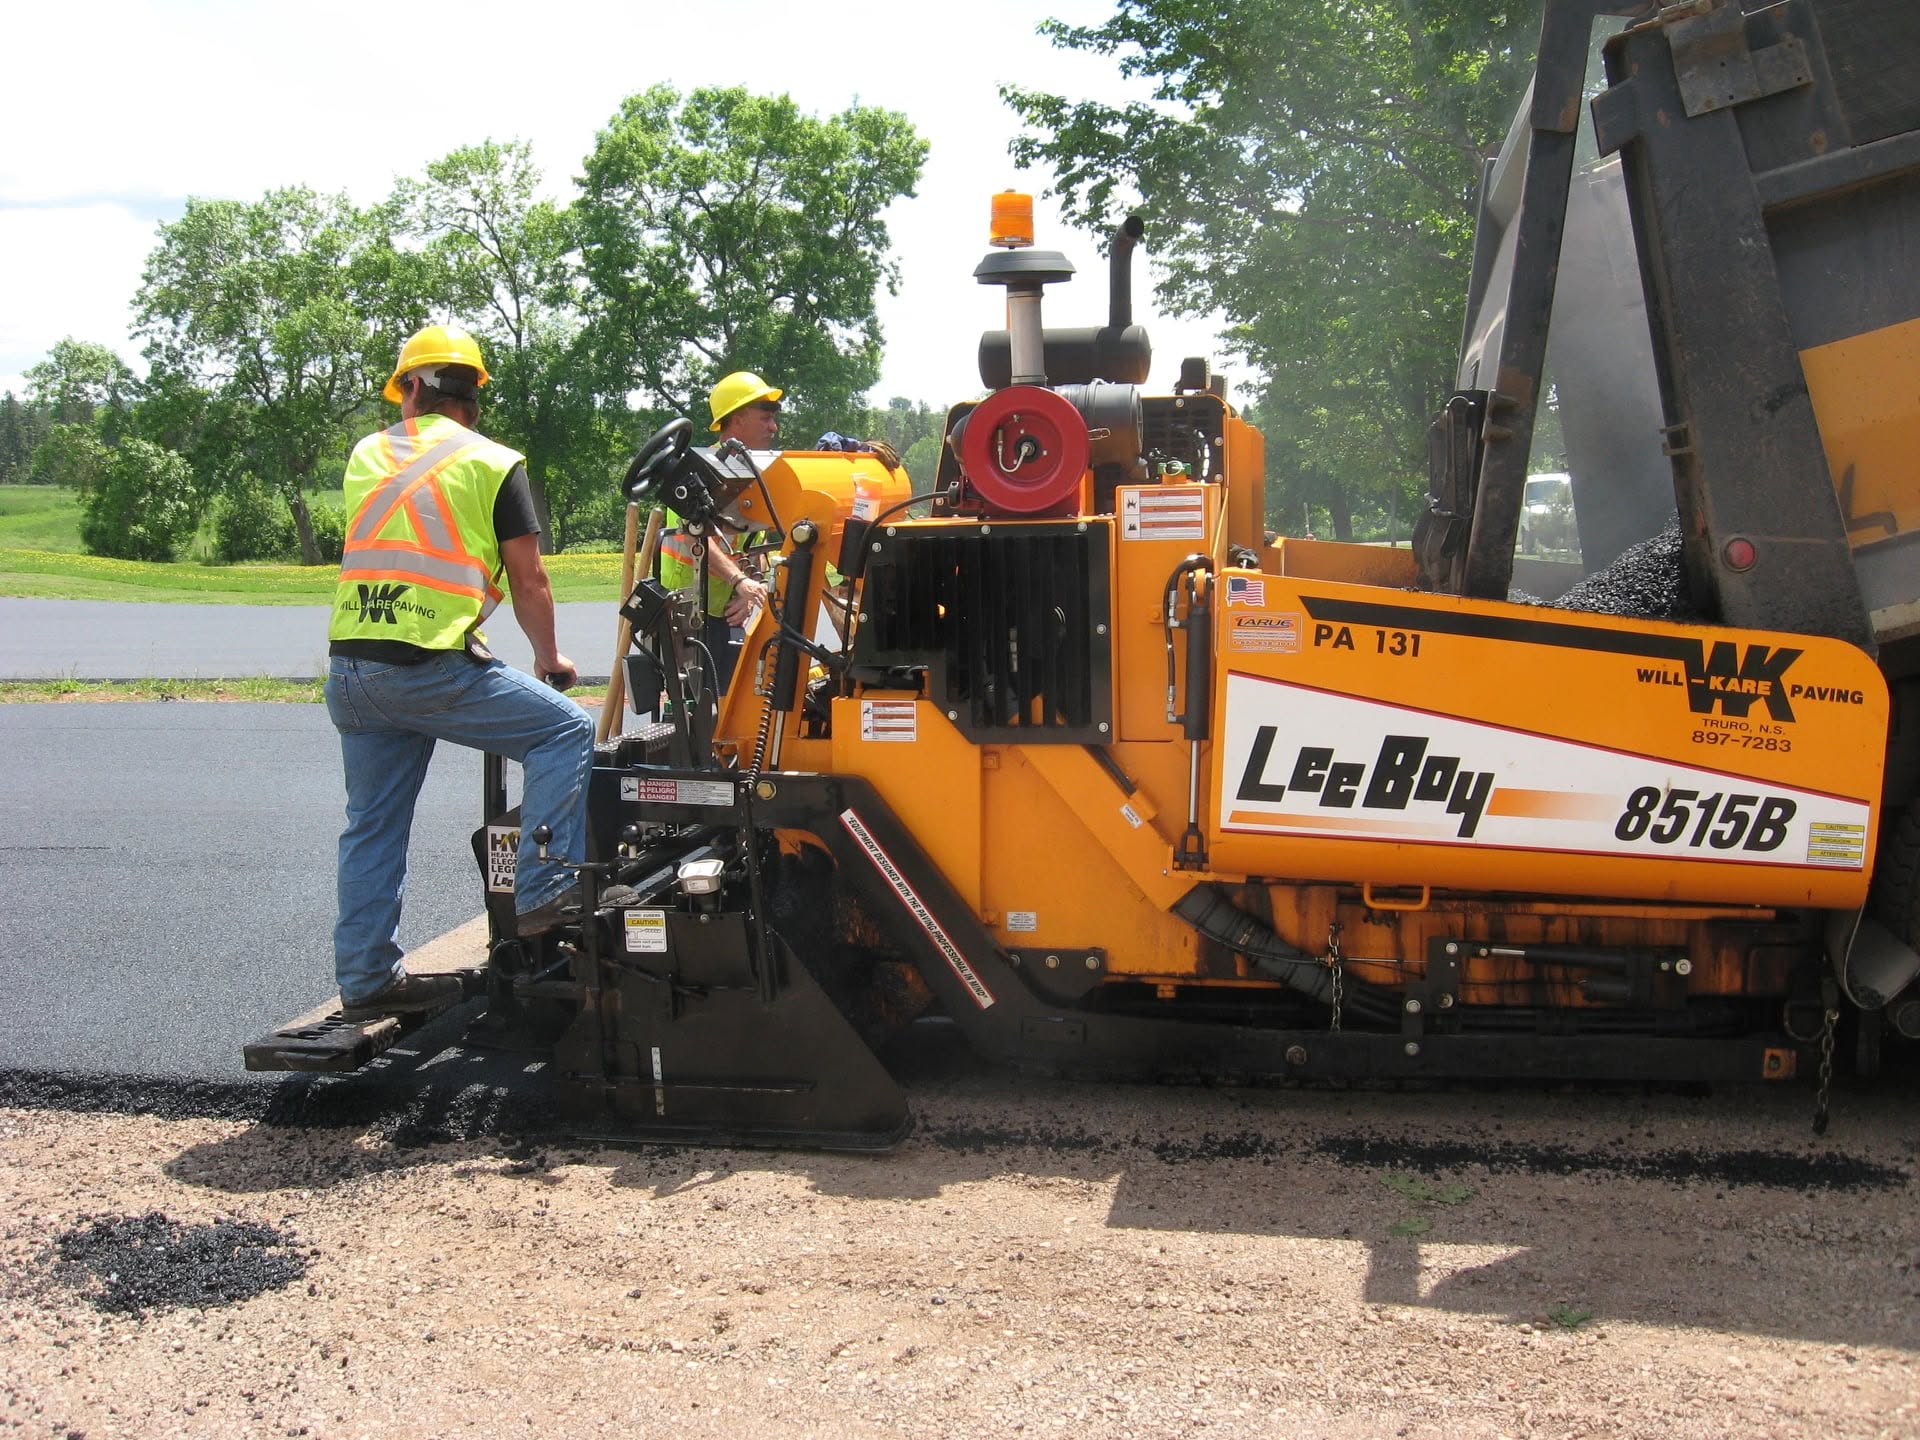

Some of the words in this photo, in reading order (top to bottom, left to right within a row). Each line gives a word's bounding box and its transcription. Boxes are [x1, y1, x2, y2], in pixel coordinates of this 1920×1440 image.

[394, 600, 436, 619] PAVING
[1314, 623, 1355, 651] PA
[1376, 630, 1421, 657] 131
[1636, 668, 1684, 686] WILL
[1790, 684, 1864, 704] PAVING
[1691, 730, 1791, 752] 897-7283
[1702, 718, 1753, 733] TRURO,
[1759, 725, 1786, 735] N.S.
[647, 780, 675, 788] DANGER
[1236, 726, 1495, 838] LeeBoy
[1614, 786, 1797, 852] 8515B
[872, 851, 900, 882] DESIGNED
[894, 880, 913, 898] WITH
[906, 896, 922, 910] THE
[915, 907, 938, 932] PAVING
[930, 929, 969, 973] PROFESSIONAL
